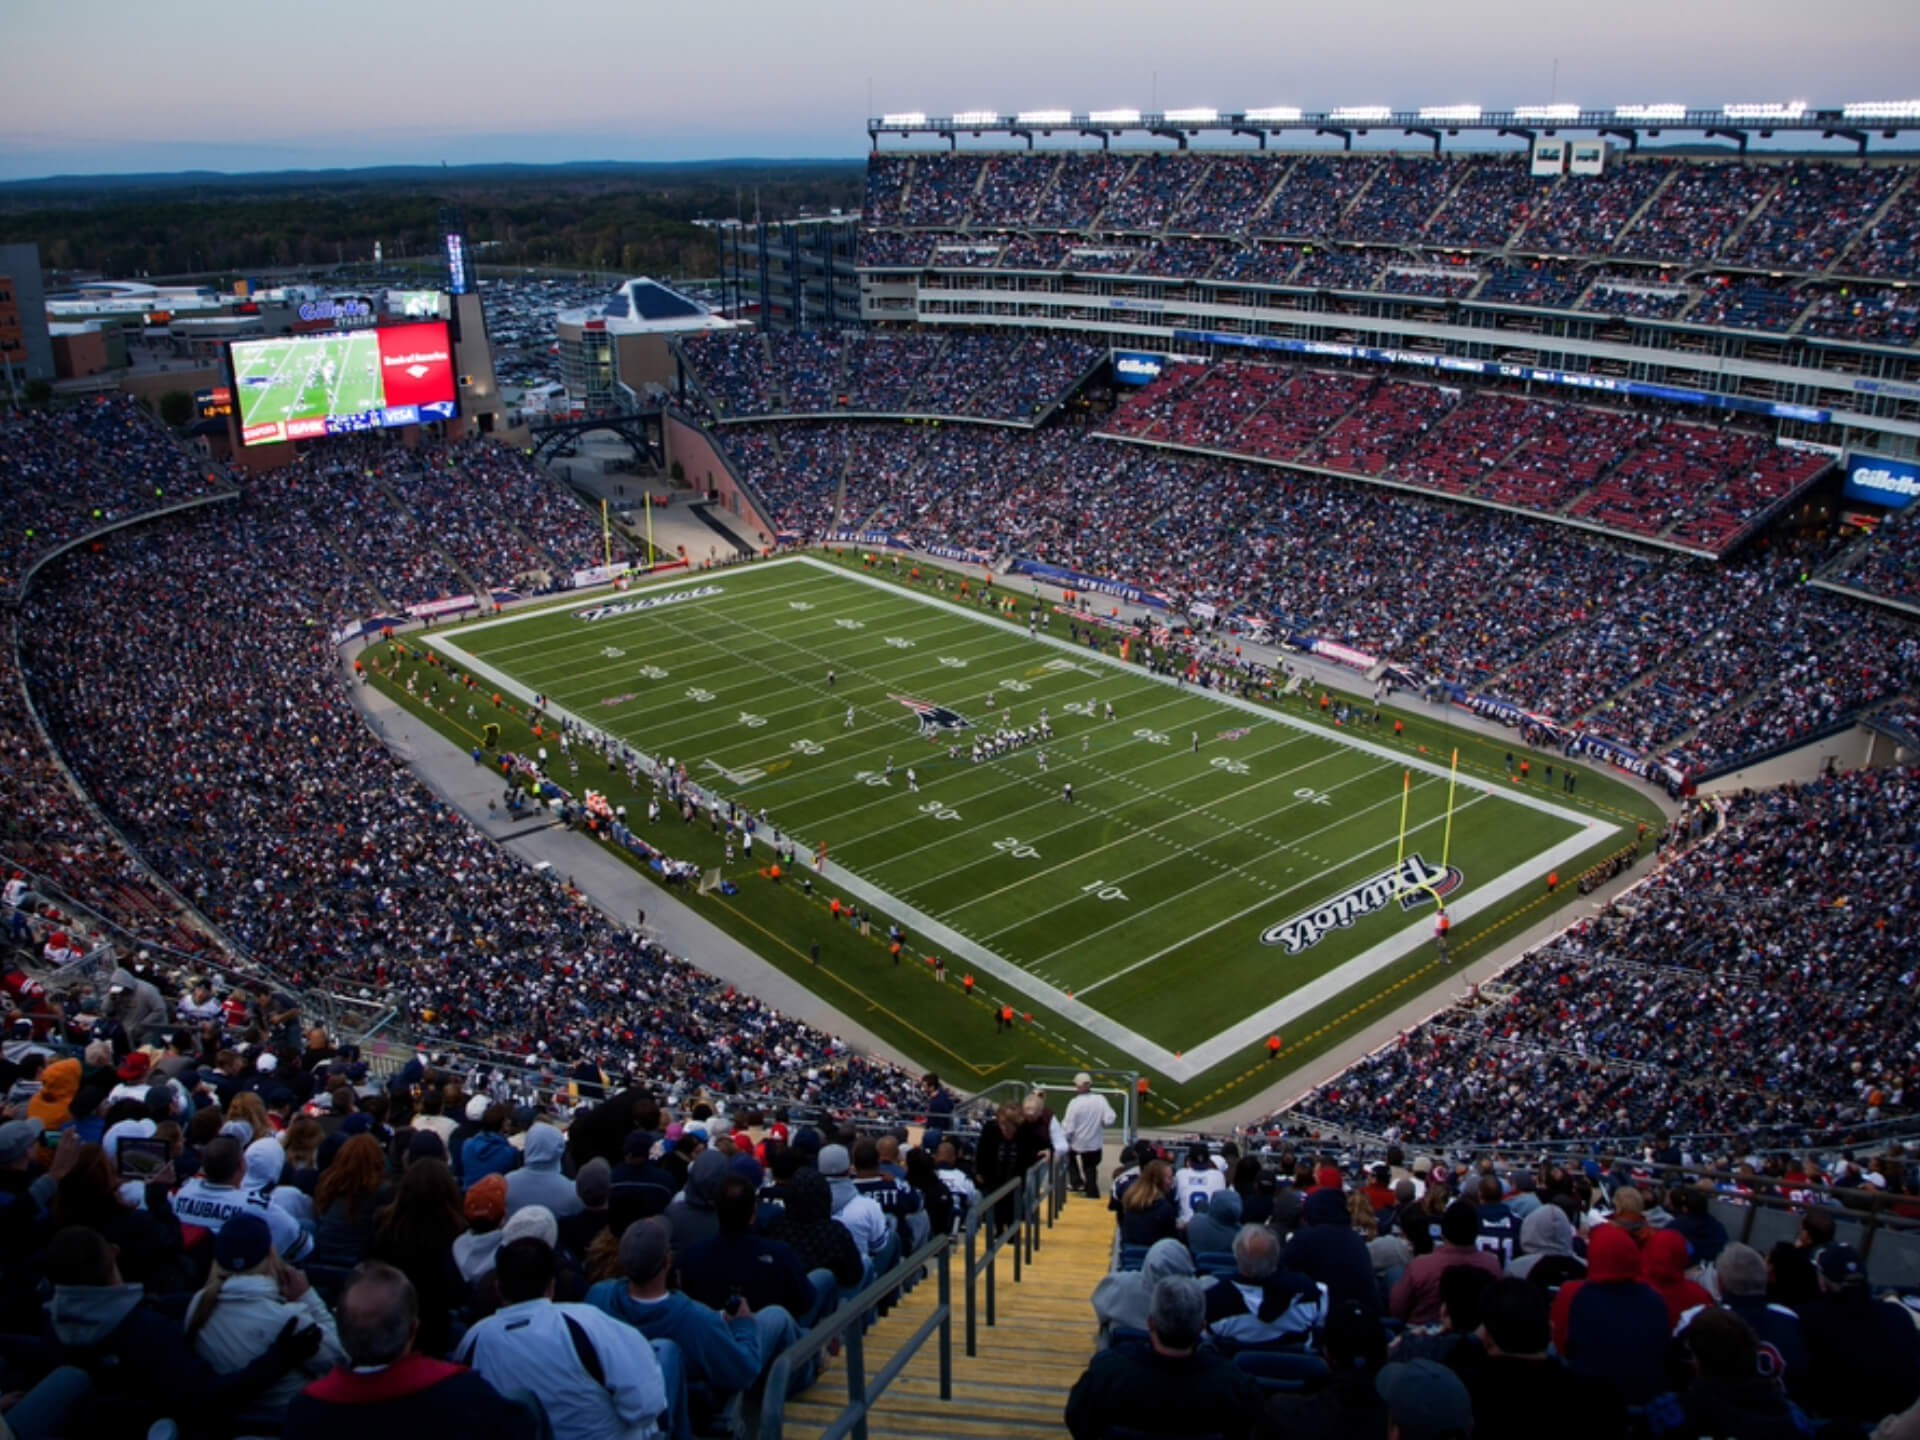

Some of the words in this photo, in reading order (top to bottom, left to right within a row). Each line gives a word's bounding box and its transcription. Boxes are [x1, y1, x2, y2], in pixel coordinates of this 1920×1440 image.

[299, 300, 369, 321] Gillette
[1117, 359, 1162, 376] Gillette
[1853, 467, 1920, 496] Gillette
[1098, 581, 1141, 600] ENGLAND
[581, 585, 724, 622] Patriots
[1465, 696, 1522, 722] PATRIOTS
[918, 800, 956, 820] 30
[992, 837, 1036, 858] 20
[1081, 879, 1122, 900] 10
[1262, 854, 1450, 953] Patriots
